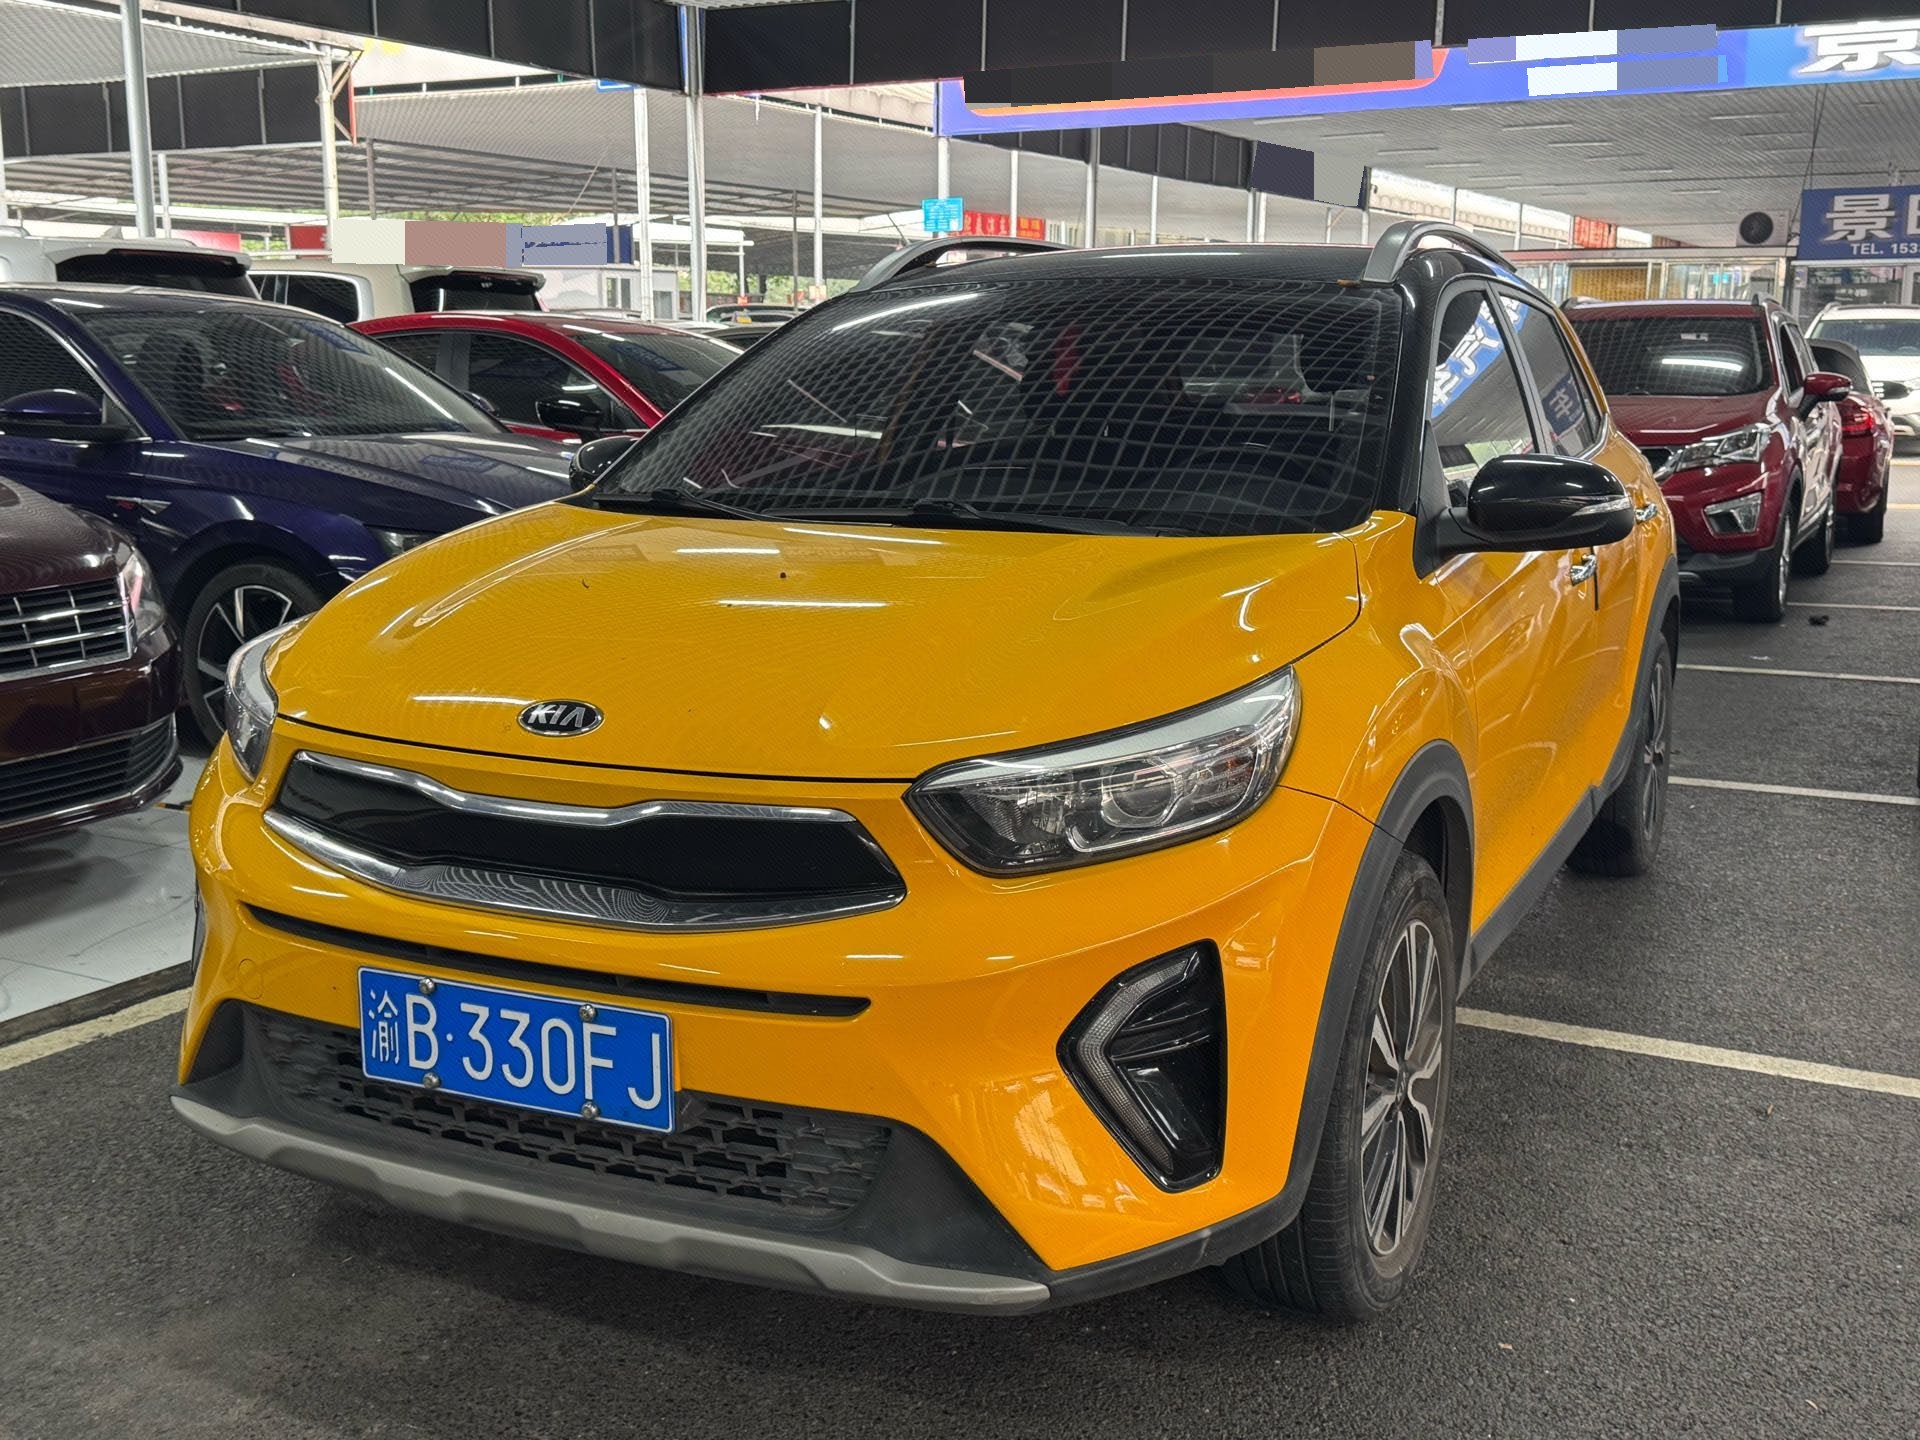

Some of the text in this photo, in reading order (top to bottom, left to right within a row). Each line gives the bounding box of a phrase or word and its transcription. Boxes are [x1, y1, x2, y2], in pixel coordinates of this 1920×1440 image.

[1850, 242, 1920, 255] TEL. 153
[527, 704, 586, 728] KIA
